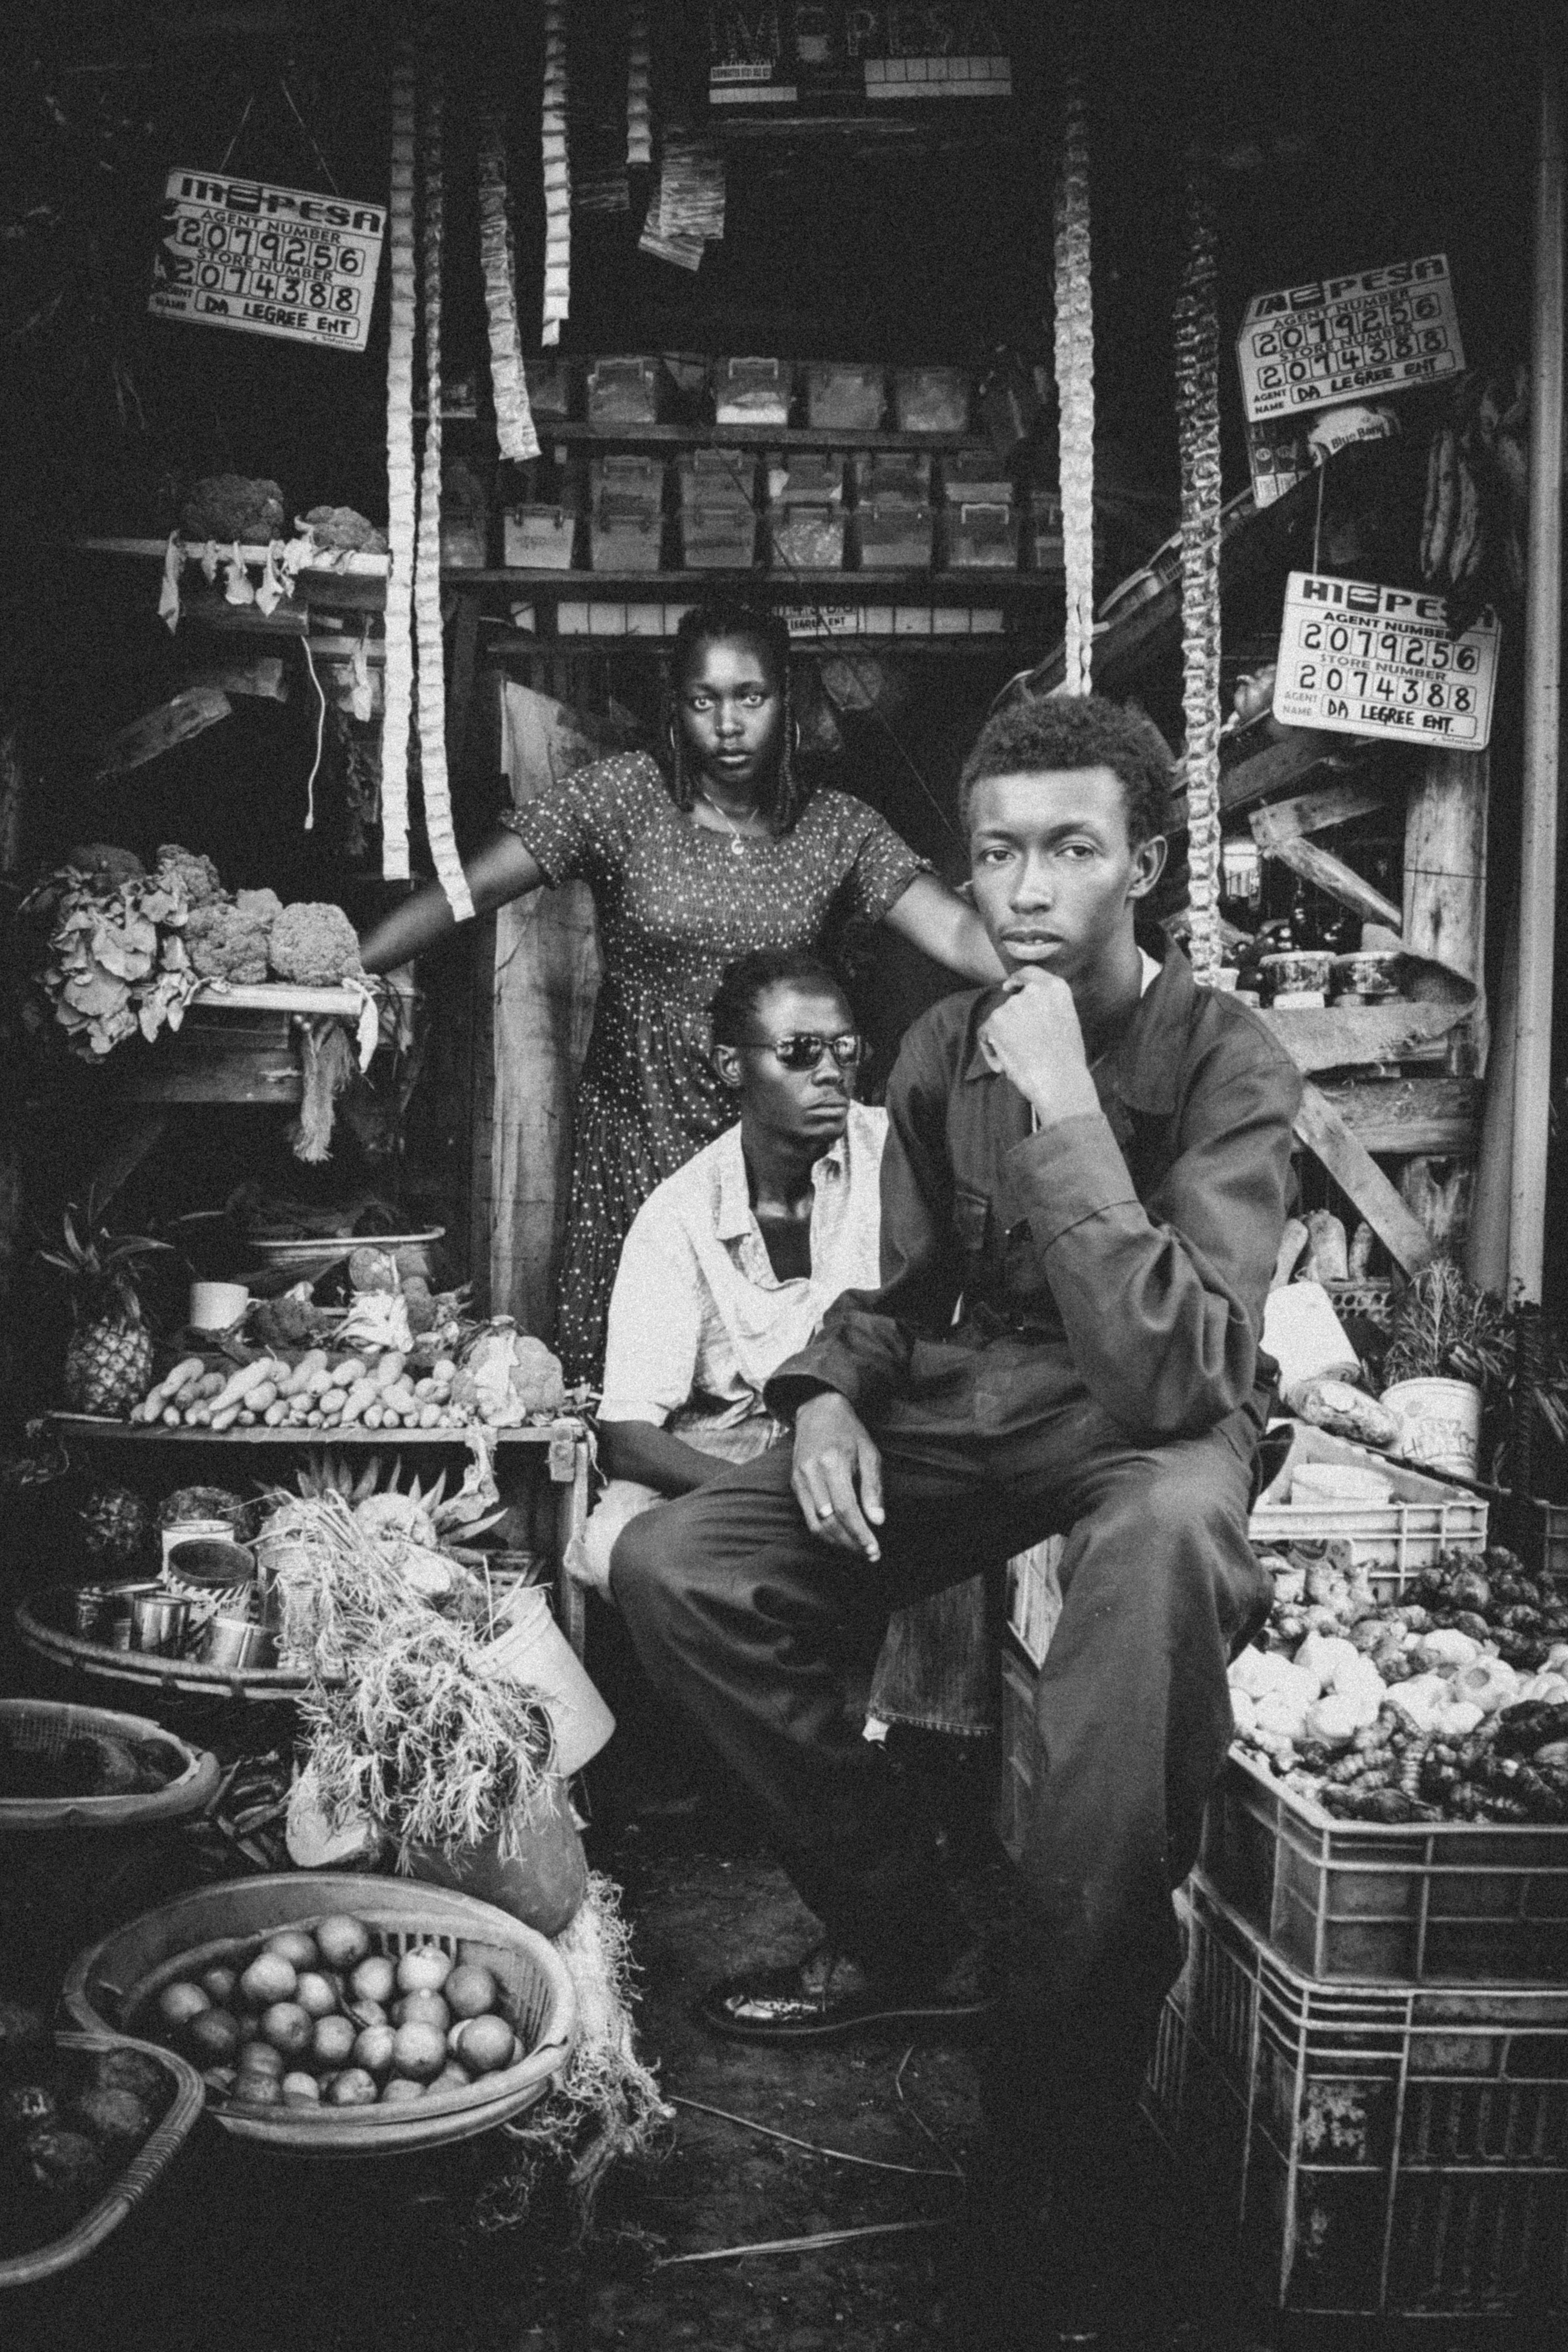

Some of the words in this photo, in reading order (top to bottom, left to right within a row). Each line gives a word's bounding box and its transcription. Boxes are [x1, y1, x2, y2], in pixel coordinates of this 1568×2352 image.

[181, 218, 358, 273] 2079256
[201, 209, 261, 228] AGENT
[267, 220, 341, 244] NUMBER
[174, 258, 353, 311] 2074388
[198, 248, 254, 267] STORE
[258, 257, 333, 283] NUMBER
[156, 296, 187, 310] NAME
[205, 296, 229, 315] DA
[243, 303, 309, 329] LEGREE
[317, 316, 350, 335] ENT
[1259, 298, 1440, 356] 2079256
[1274, 305, 1330, 329] AGENT
[1336, 288, 1411, 314] NUMBER
[1263, 330, 1441, 389] 2074388
[1279, 338, 1335, 362] STORE
[1340, 323, 1416, 348] NUMBER
[1254, 389, 1287, 403] AGENT
[1255, 401, 1285, 415] NAME
[1298, 385, 1320, 403] DA
[1331, 368, 1395, 392] LEGREE
[1404, 357, 1437, 377] ENT
[1331, 433, 1356, 450] Blue
[828, 617, 845, 626] ENT
[1324, 612, 1379, 628] AGENT
[1305, 623, 1475, 671] 2079256
[1321, 653, 1370, 668] STORE
[1376, 662, 1446, 681] NUMBER
[1285, 691, 1318, 703] AGENT
[1300, 665, 1470, 712] 2074388
[1283, 705, 1312, 716] NAME
[1328, 699, 1348, 719] DA
[1361, 705, 1415, 725] LEGREE
